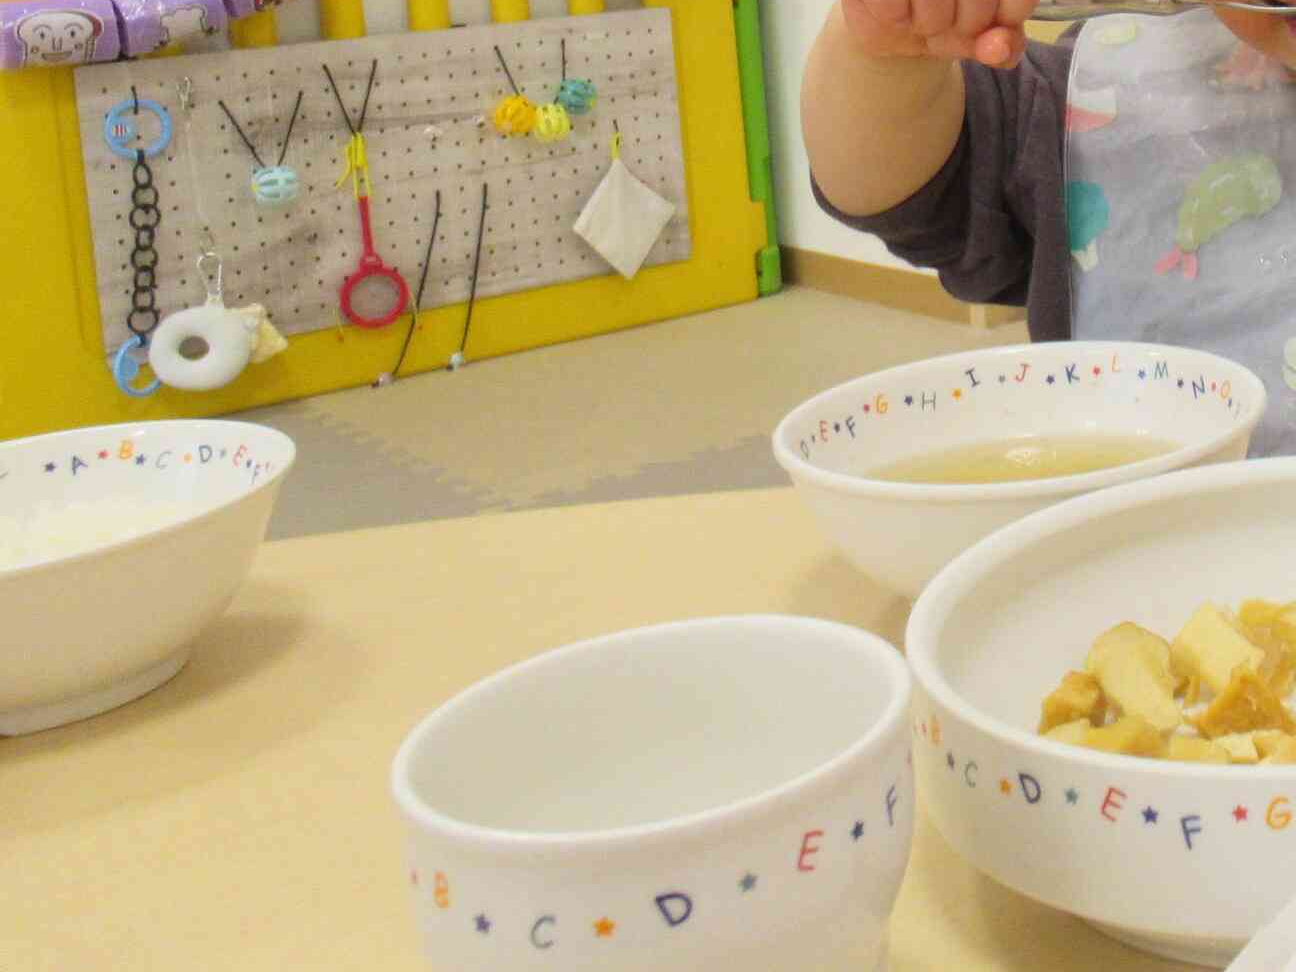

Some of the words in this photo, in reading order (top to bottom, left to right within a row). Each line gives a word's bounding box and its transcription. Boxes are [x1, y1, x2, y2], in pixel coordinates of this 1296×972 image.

[873, 394, 889, 414] G
[921, 391, 936, 412] H
[965, 368, 981, 388] I
[1014, 363, 1032, 383] J
[1065, 364, 1080, 384] K
[1112, 355, 1122, 373] L
[1153, 361, 1169, 379] M
[1192, 374, 1206, 400] N
[70, 455, 89, 475] A
[117, 439, 135, 460] B
[155, 450, 172, 470] C
[199, 445, 213, 463] D
[964, 760, 979, 788] C
[1018, 772, 1042, 805] D
[1100, 786, 1128, 823] E
[1180, 815, 1202, 851] F
[1265, 796, 1293, 831] G
[530, 914, 557, 949] C
[655, 892, 693, 927] D
[797, 829, 824, 872] E
